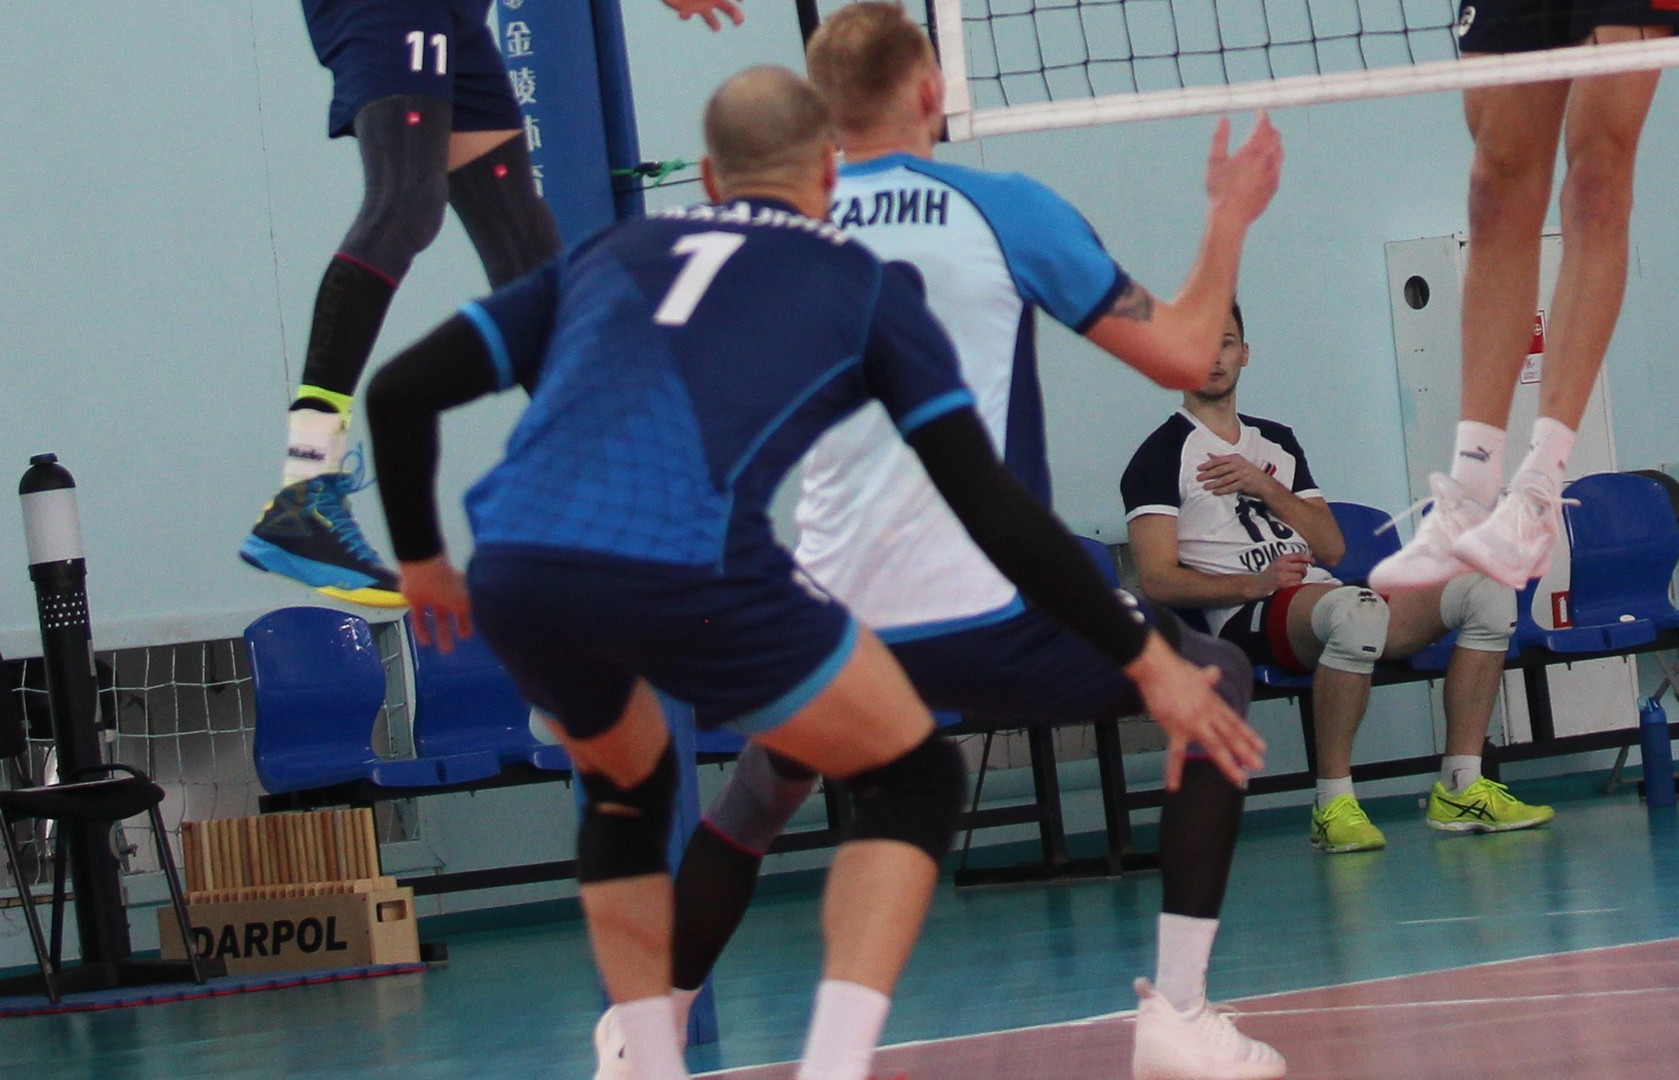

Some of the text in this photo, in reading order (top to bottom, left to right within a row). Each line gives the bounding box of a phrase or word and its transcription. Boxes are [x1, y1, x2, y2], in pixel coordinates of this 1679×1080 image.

[405, 30, 448, 75] 11
[653, 230, 747, 326] 1
[190, 916, 348, 960] DARPOL
